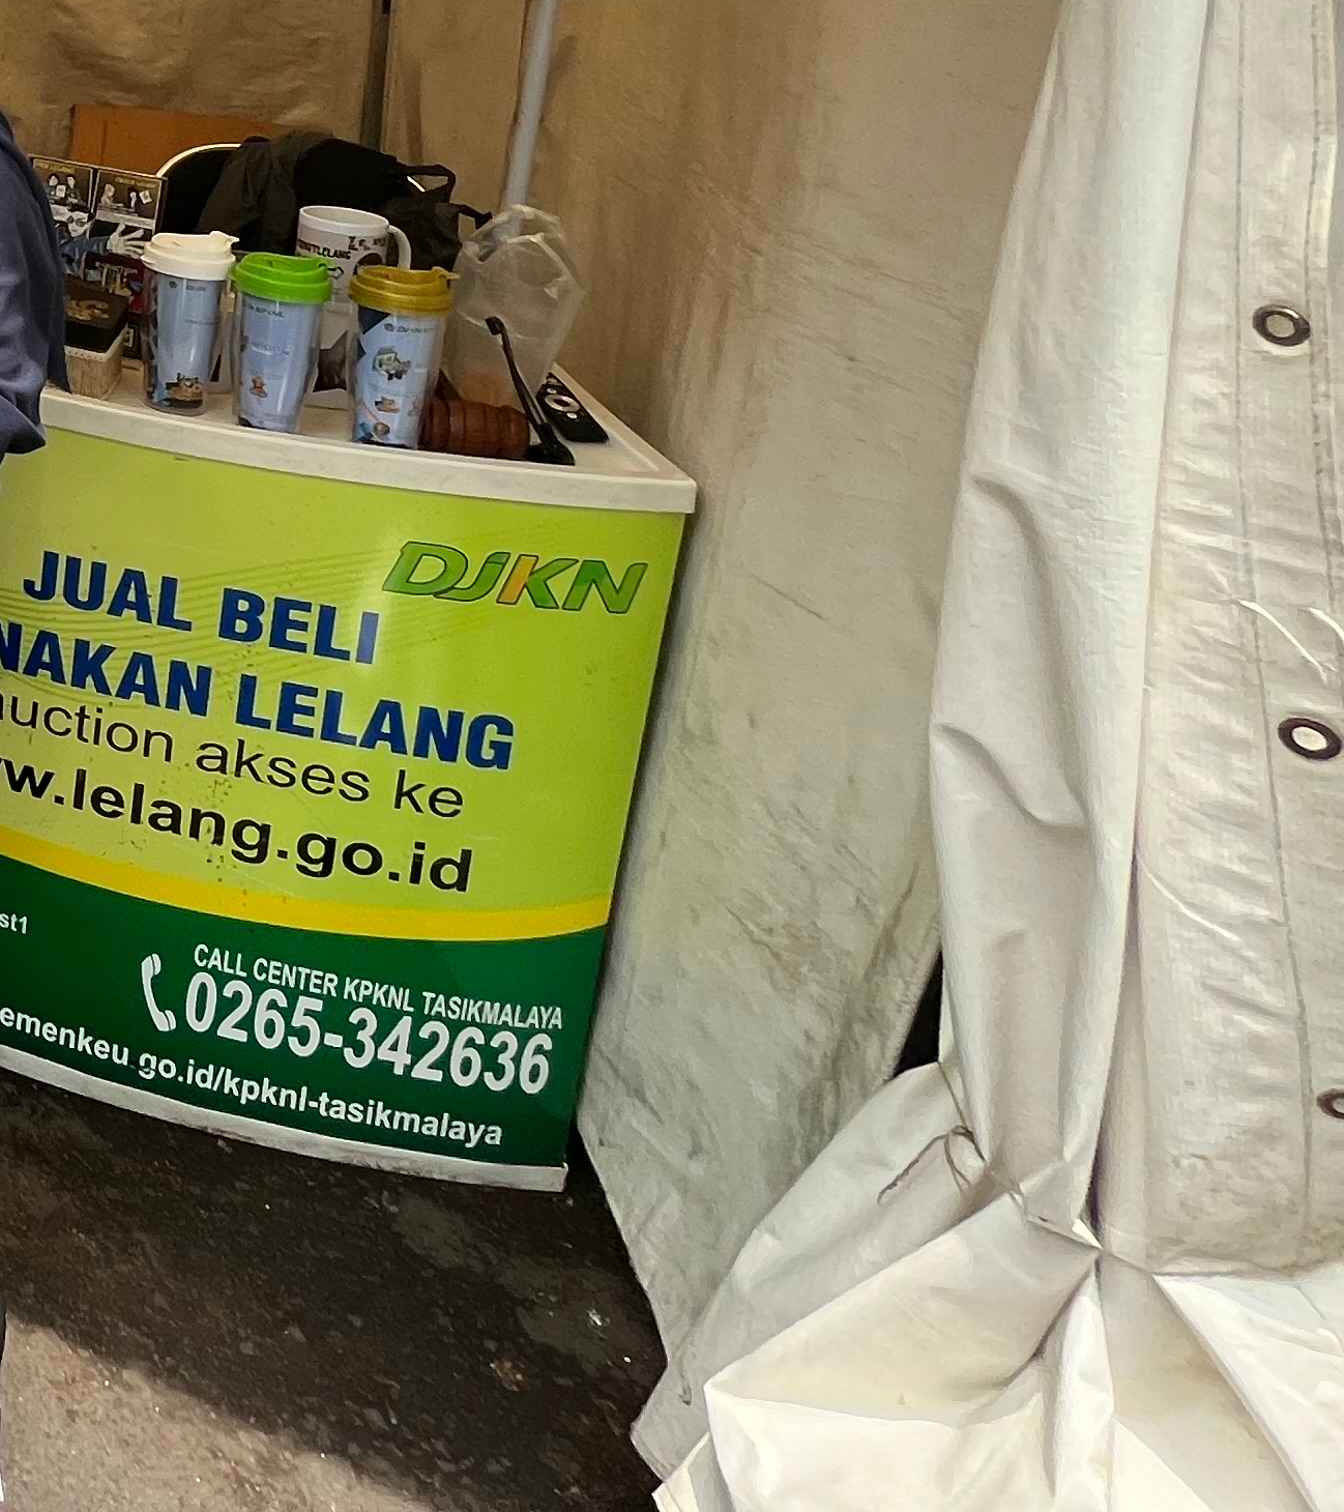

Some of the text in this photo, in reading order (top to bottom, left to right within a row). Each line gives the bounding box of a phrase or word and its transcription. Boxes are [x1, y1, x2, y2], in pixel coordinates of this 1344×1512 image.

[23, 550, 382, 666] JUAL BELI
[382, 540, 648, 614] DJKN
[235, 673, 515, 771] LELANG
[195, 738, 371, 804] akses
[393, 769, 465, 821] ke
[193, 942, 564, 1030] CALL CENTER KPKNL TASIKMALAYA
[184, 971, 554, 1096] 0265-342636
